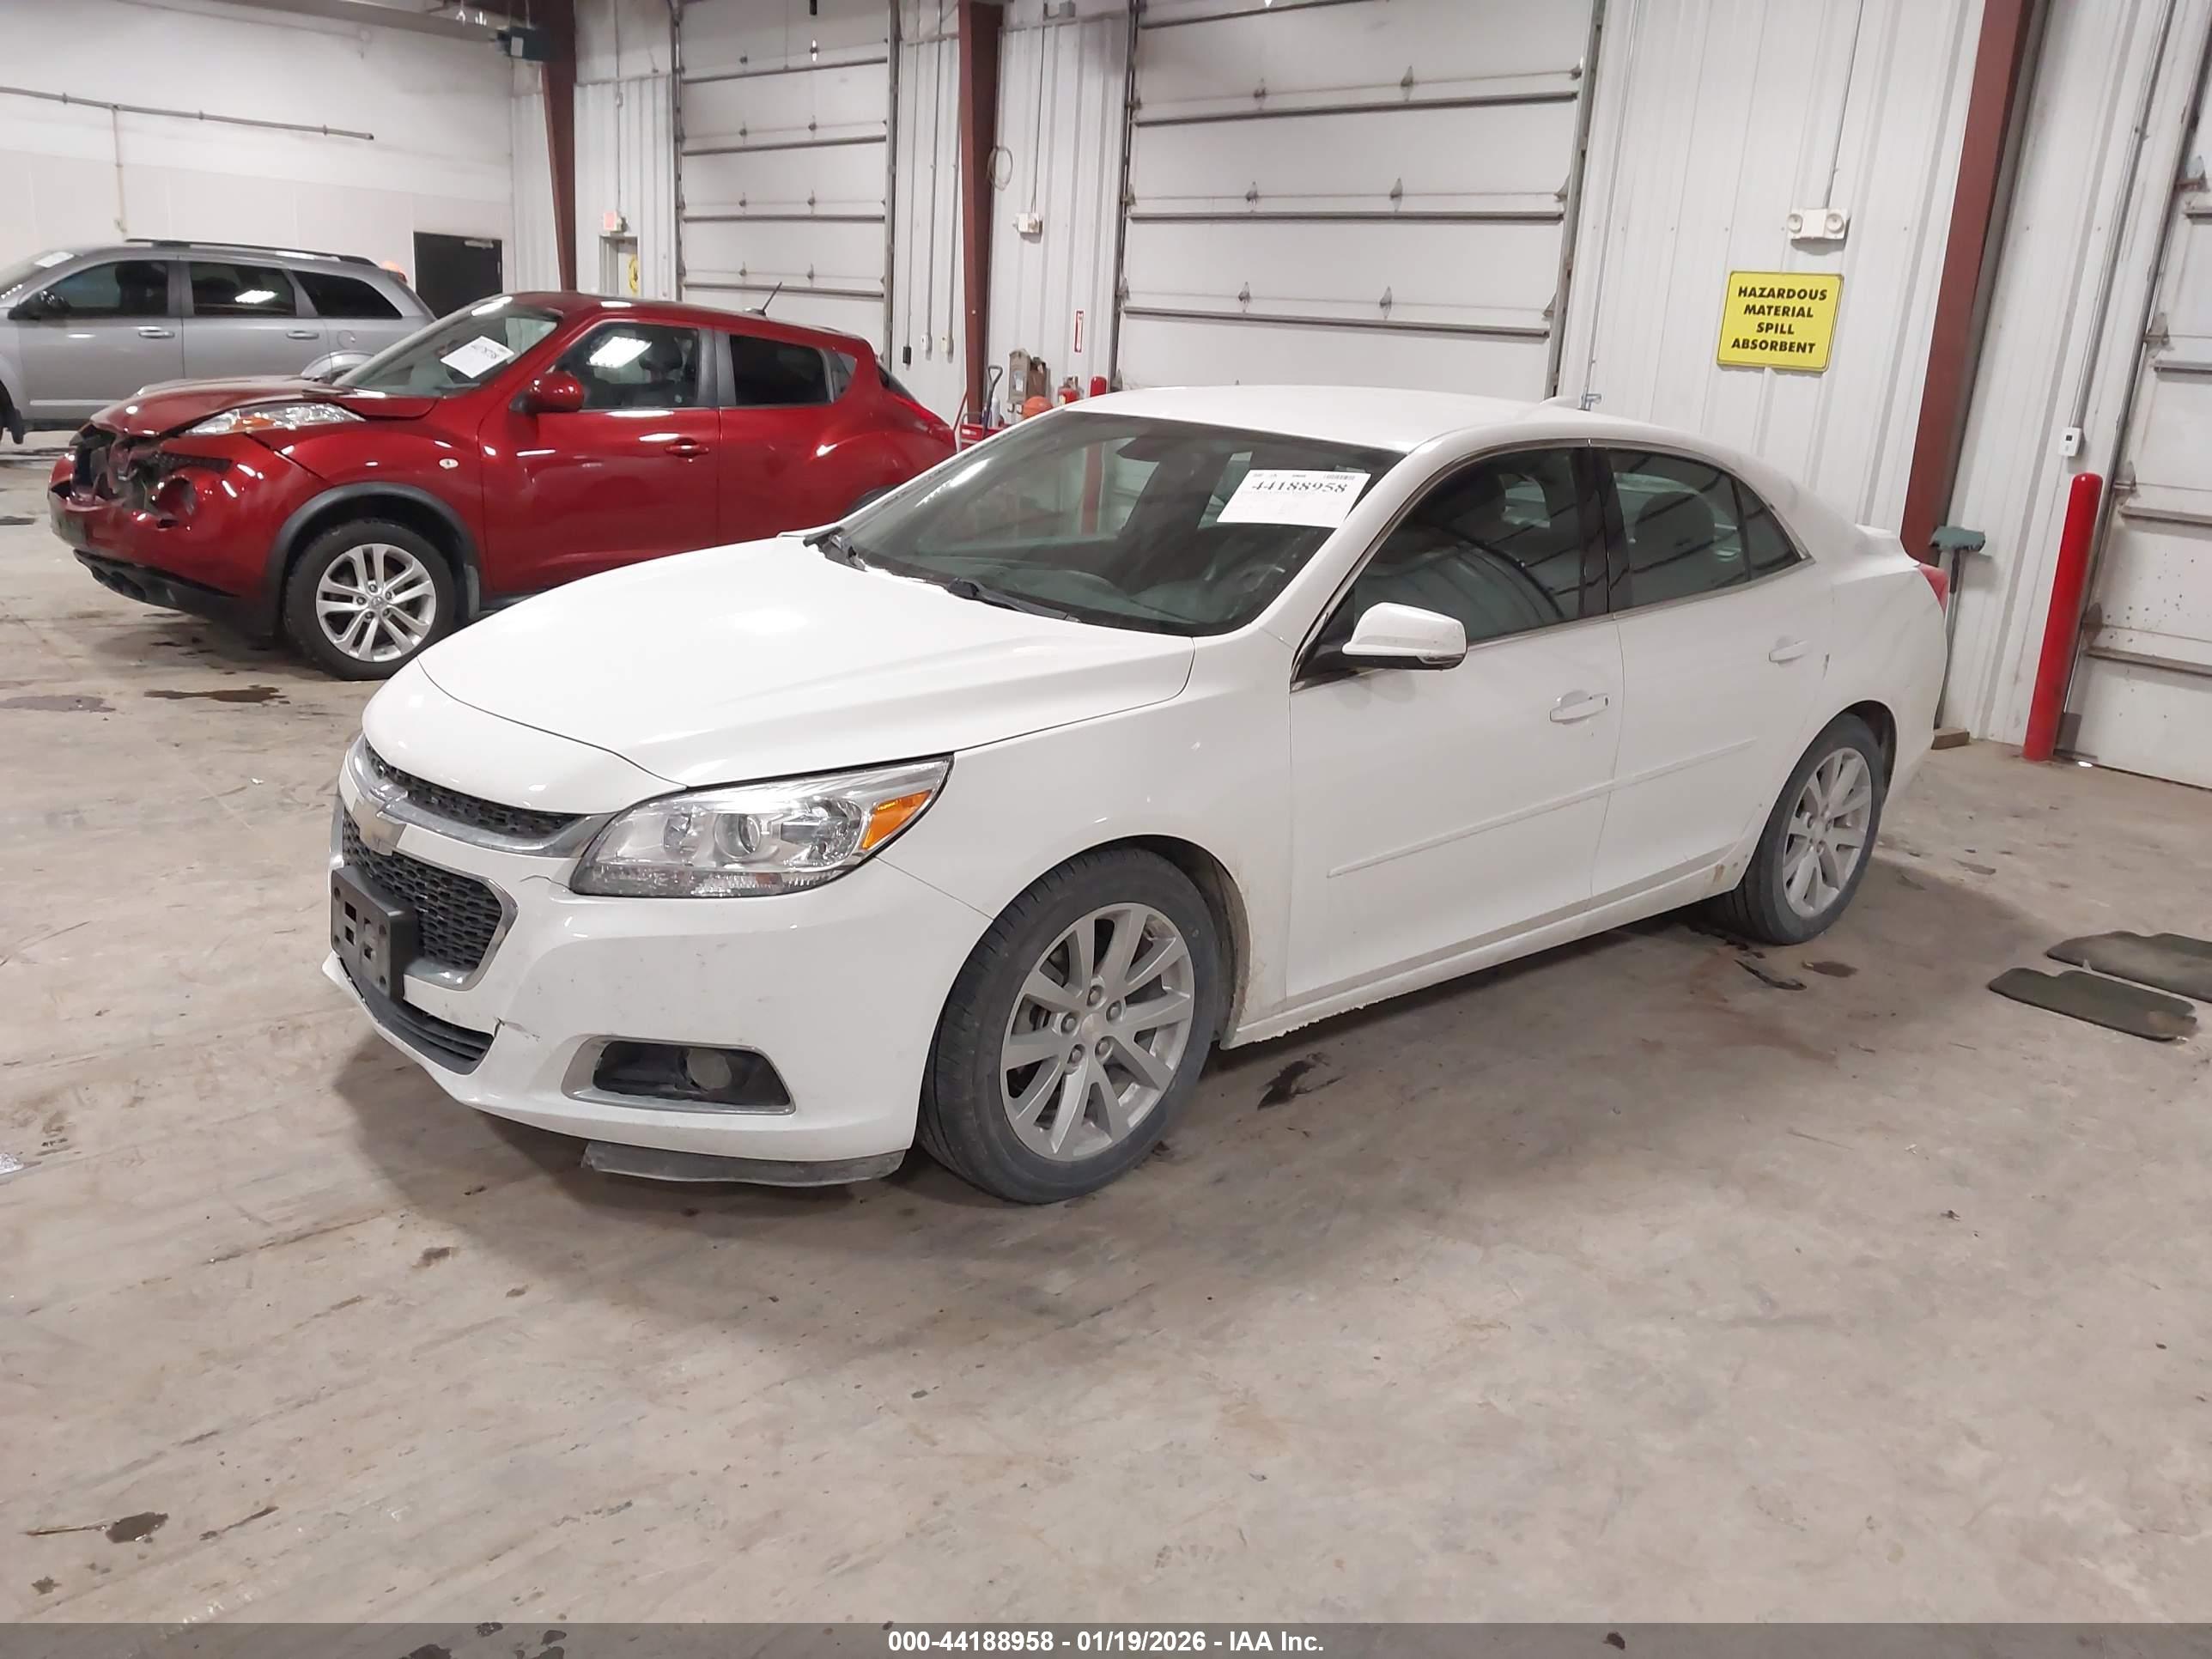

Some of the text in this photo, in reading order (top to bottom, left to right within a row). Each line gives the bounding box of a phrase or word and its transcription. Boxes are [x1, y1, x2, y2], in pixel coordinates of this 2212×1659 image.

[1738, 286, 1827, 301] HAZARDOUS
[1743, 304, 1814, 318] MATERIAL
[1757, 322, 1795, 335] SPILL
[1732, 338, 1815, 354] ABSORBENT
[1252, 481, 1347, 493] 44188958
